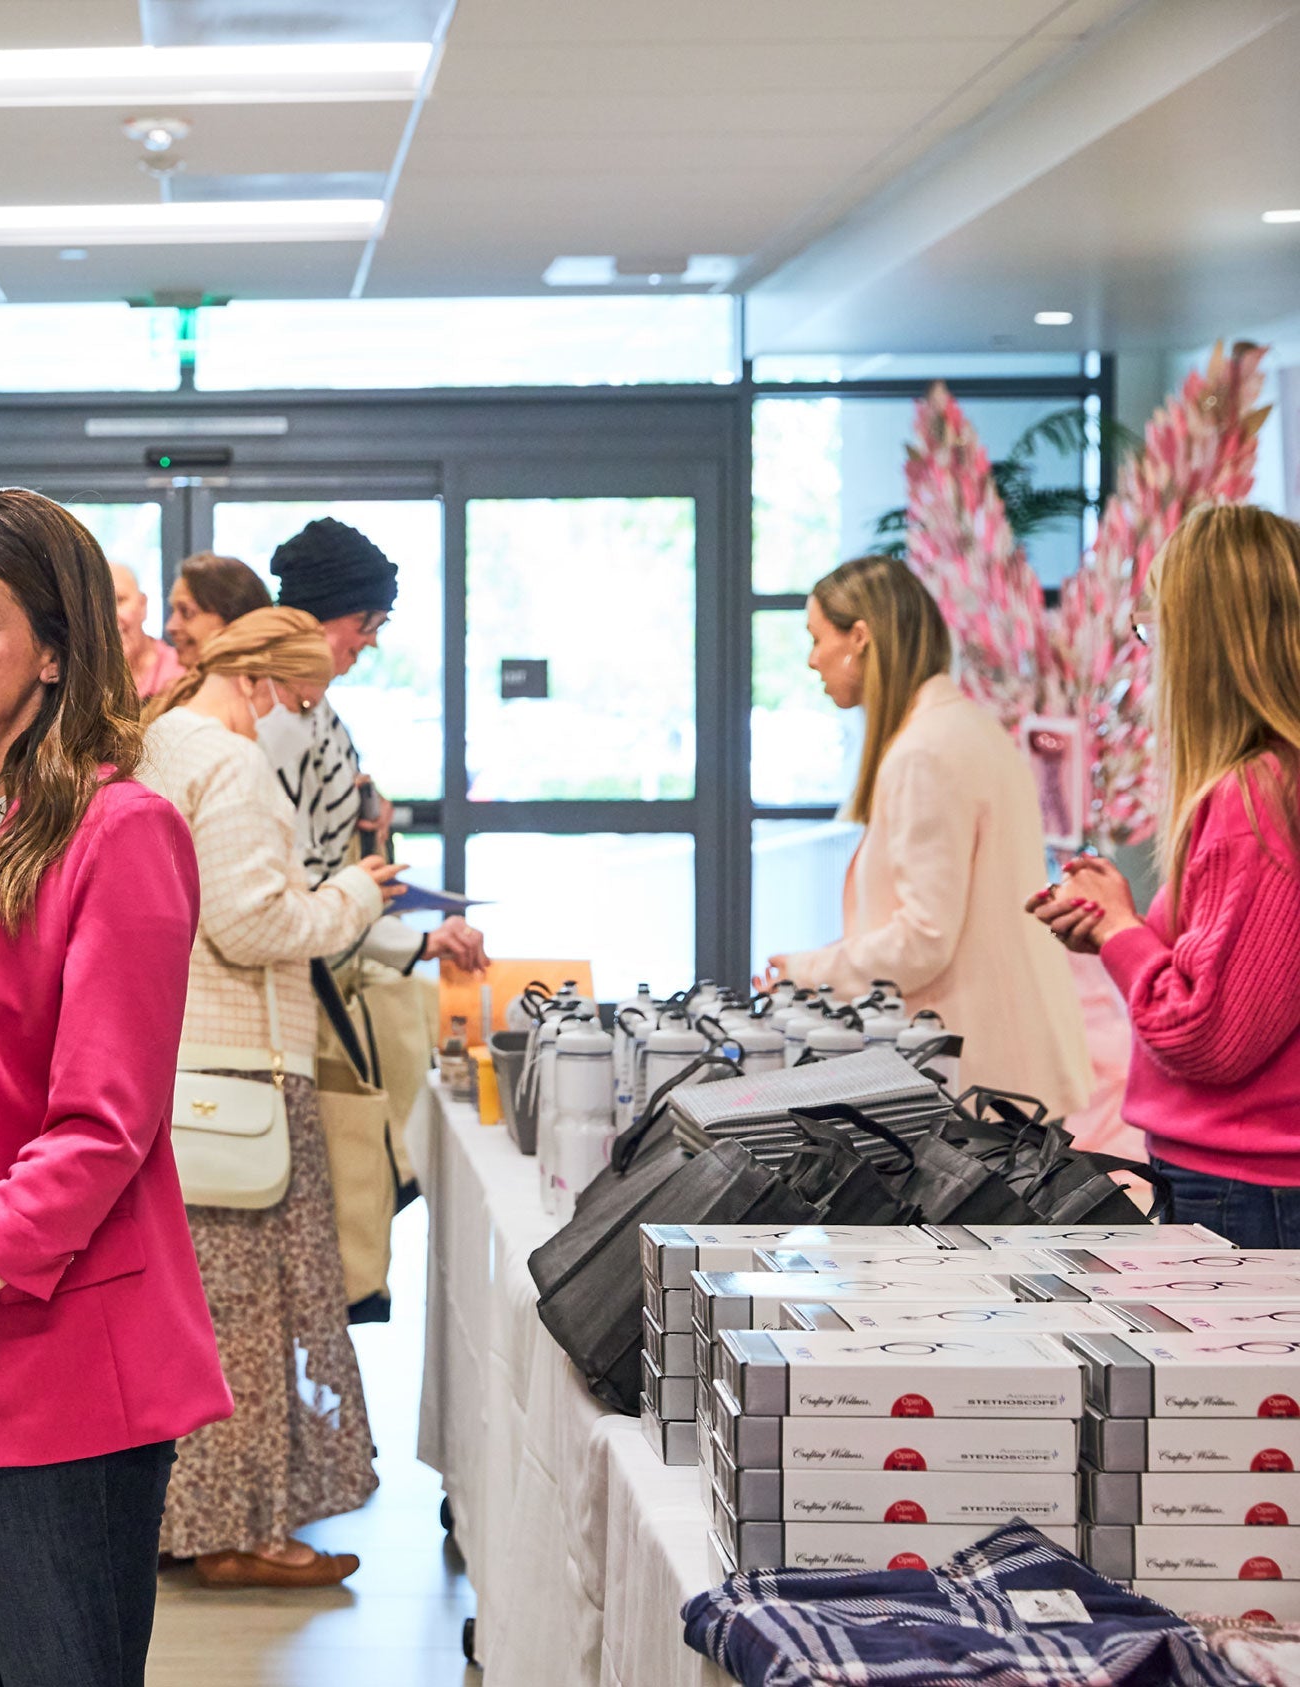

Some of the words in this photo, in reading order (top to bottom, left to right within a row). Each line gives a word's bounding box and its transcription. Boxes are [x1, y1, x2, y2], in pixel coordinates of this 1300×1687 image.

[799, 1393, 834, 1408] Crafting
[901, 1397, 924, 1407] Open
[1267, 1397, 1291, 1407] Open
[792, 1447, 826, 1461] Crafting
[894, 1451, 917, 1461] Open
[1261, 1451, 1284, 1461] Open
[793, 1499, 827, 1513] Crafting
[895, 1503, 917, 1512] Open
[1255, 1506, 1278, 1515] Open
[795, 1552, 829, 1566] Crafting
[896, 1556, 919, 1566] Open
[1249, 1560, 1272, 1569] Open
